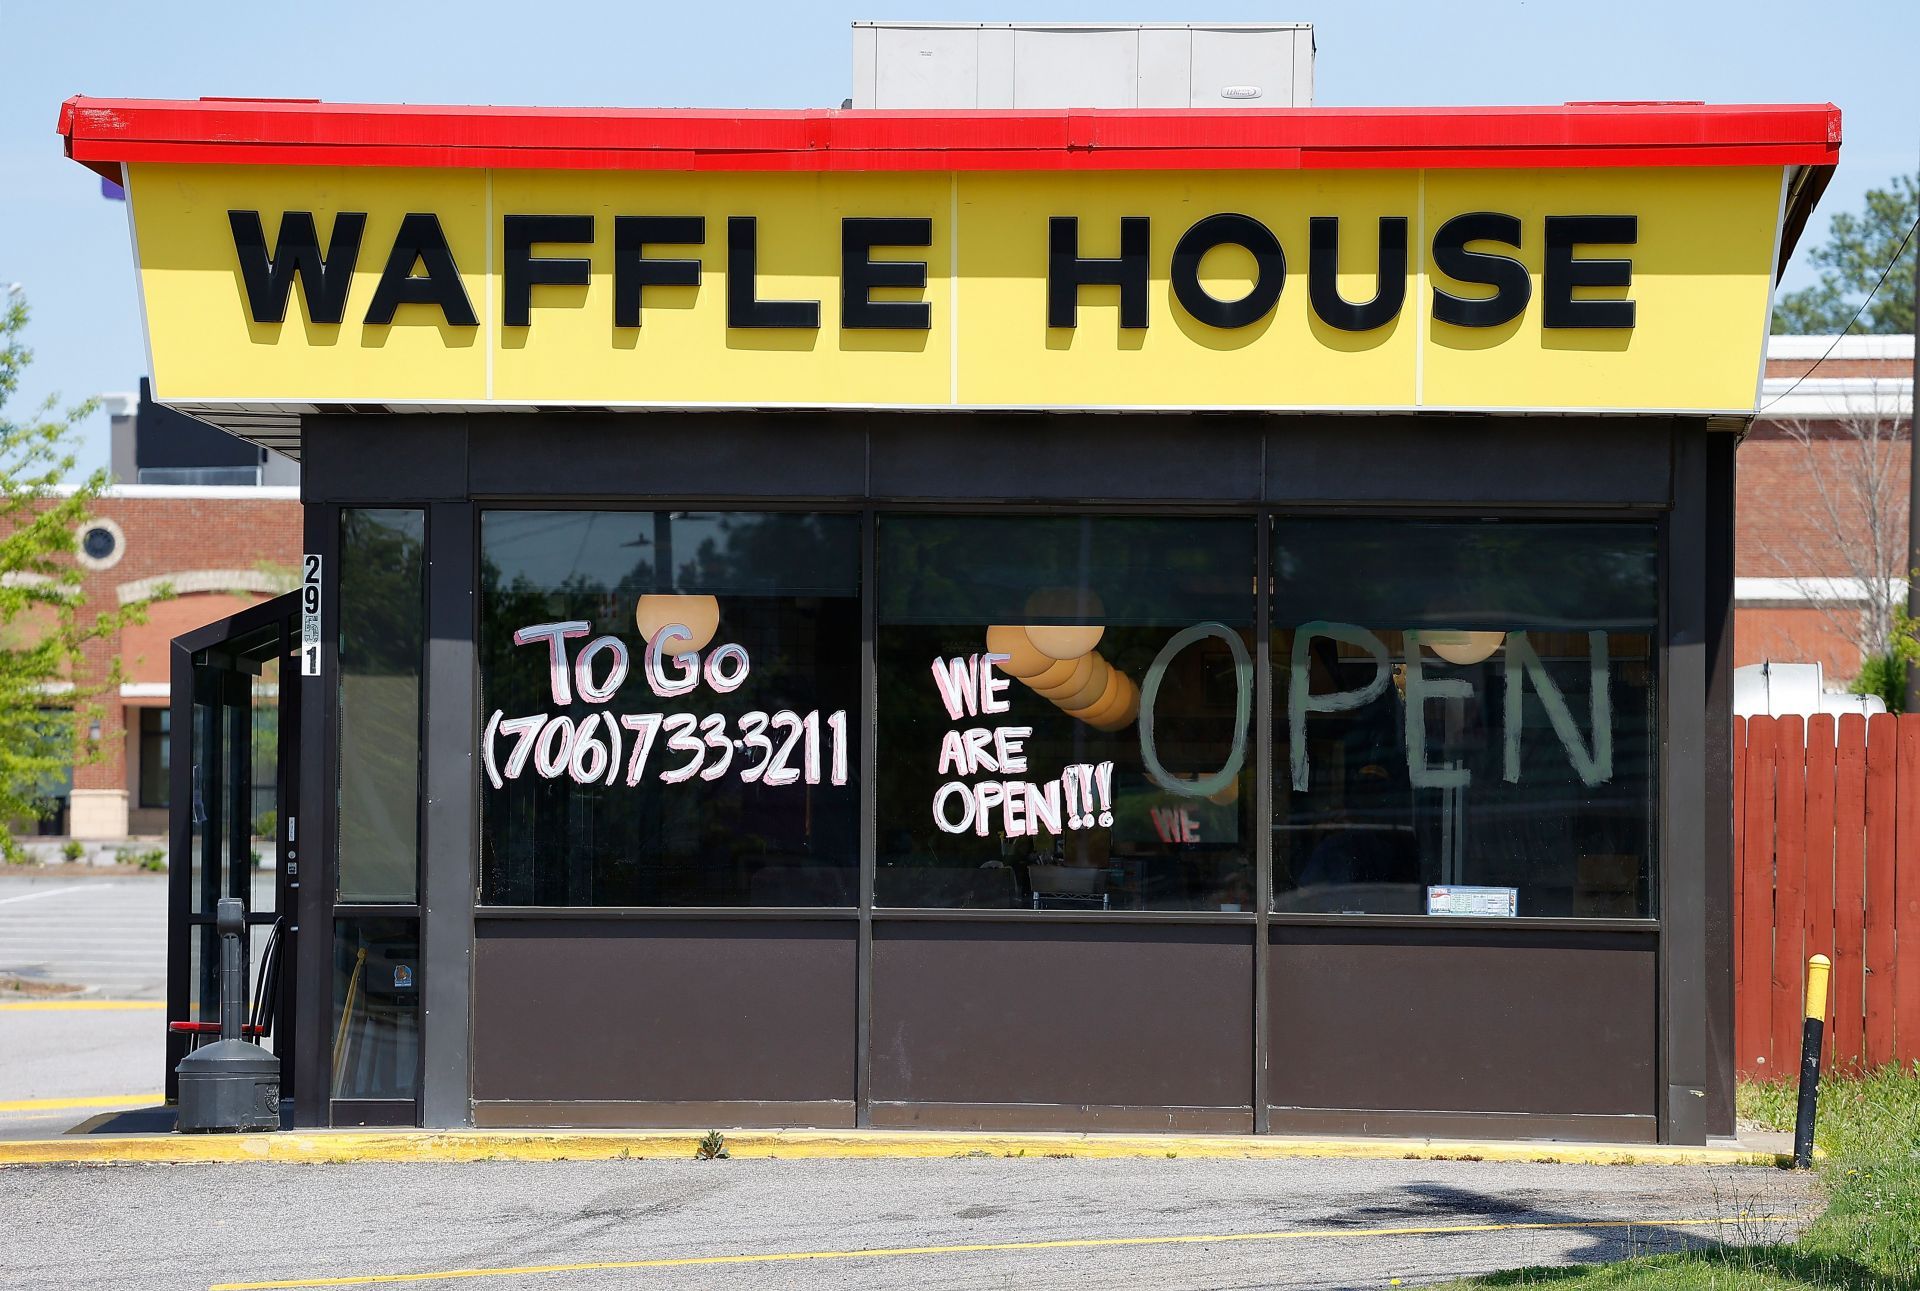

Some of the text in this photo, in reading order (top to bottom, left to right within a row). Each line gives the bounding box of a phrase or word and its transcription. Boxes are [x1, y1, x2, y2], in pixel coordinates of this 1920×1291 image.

[227, 209, 1638, 332] WAFFLE HOUSE
[931, 653, 1012, 720] WE
[1139, 621, 1613, 797] OPEN
[938, 726, 1033, 776] ARE
[932, 760, 1114, 838] OPEN!!!
